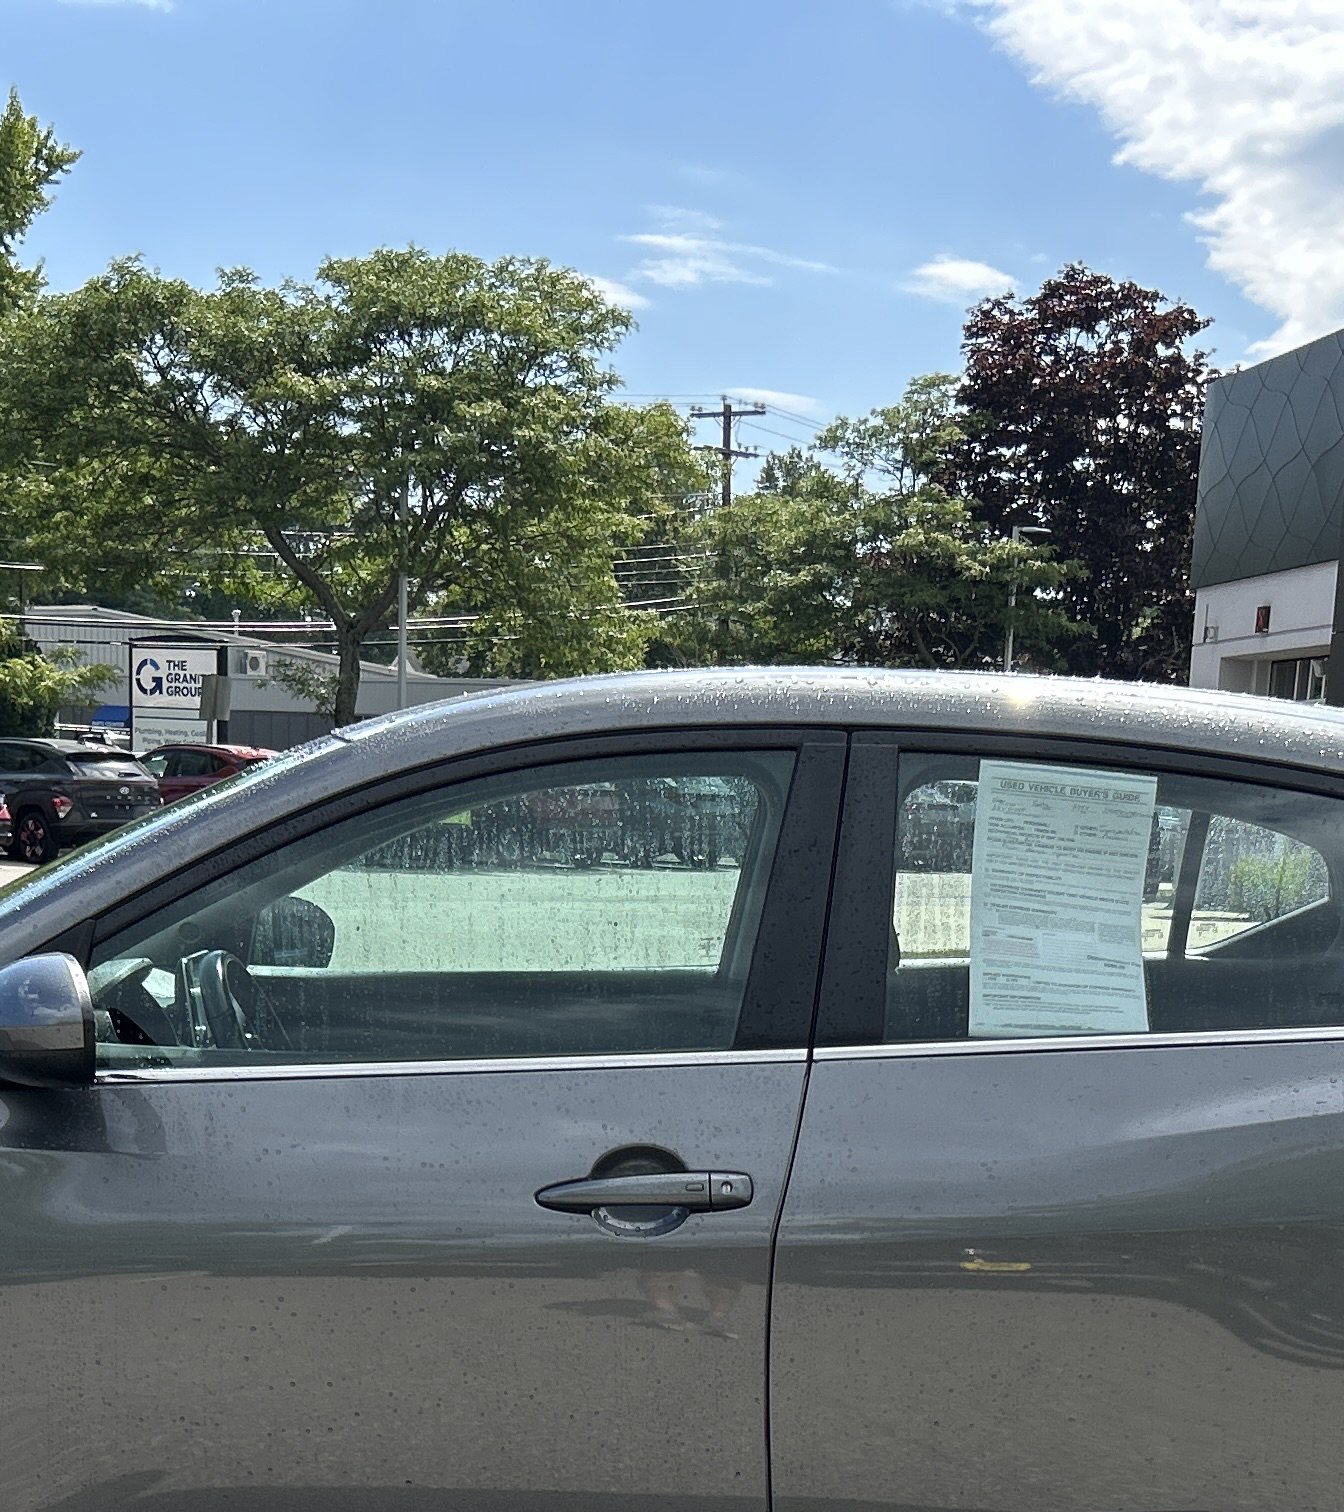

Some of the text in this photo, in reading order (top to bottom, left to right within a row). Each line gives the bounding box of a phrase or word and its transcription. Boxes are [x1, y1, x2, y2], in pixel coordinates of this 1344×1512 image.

[166, 660, 187, 671] THE
[166, 673, 201, 684] GRANI
[999, 779, 1025, 791] USED
[1028, 783, 1067, 796] VEHICLE
[1069, 787, 1109, 800] BUYER'S
